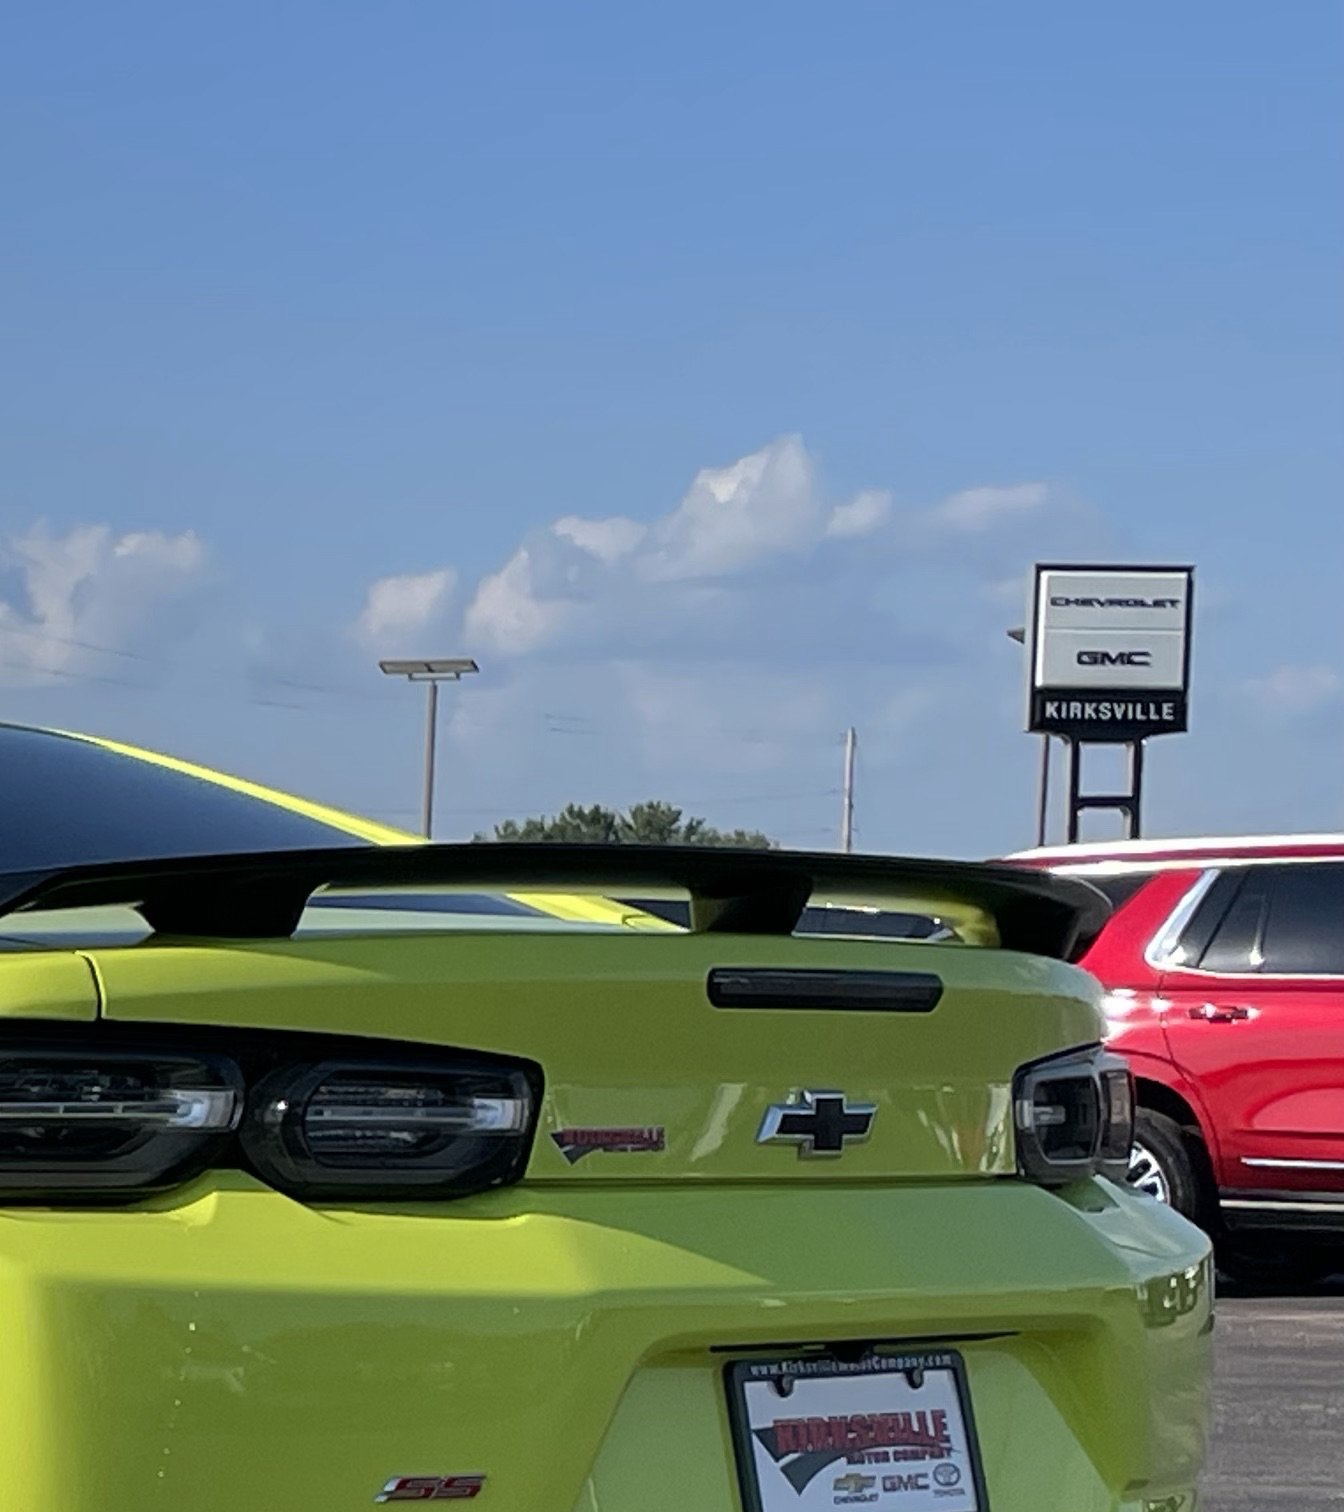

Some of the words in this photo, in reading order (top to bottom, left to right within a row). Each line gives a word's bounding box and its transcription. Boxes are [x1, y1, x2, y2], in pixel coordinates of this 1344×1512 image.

[1050, 597, 1180, 609] CHEVROLET
[1076, 651, 1152, 667] GMC
[1045, 701, 1175, 720] KIRKSVILLE
[375, 1474, 486, 1502] SS
[882, 1473, 930, 1493] GMC
